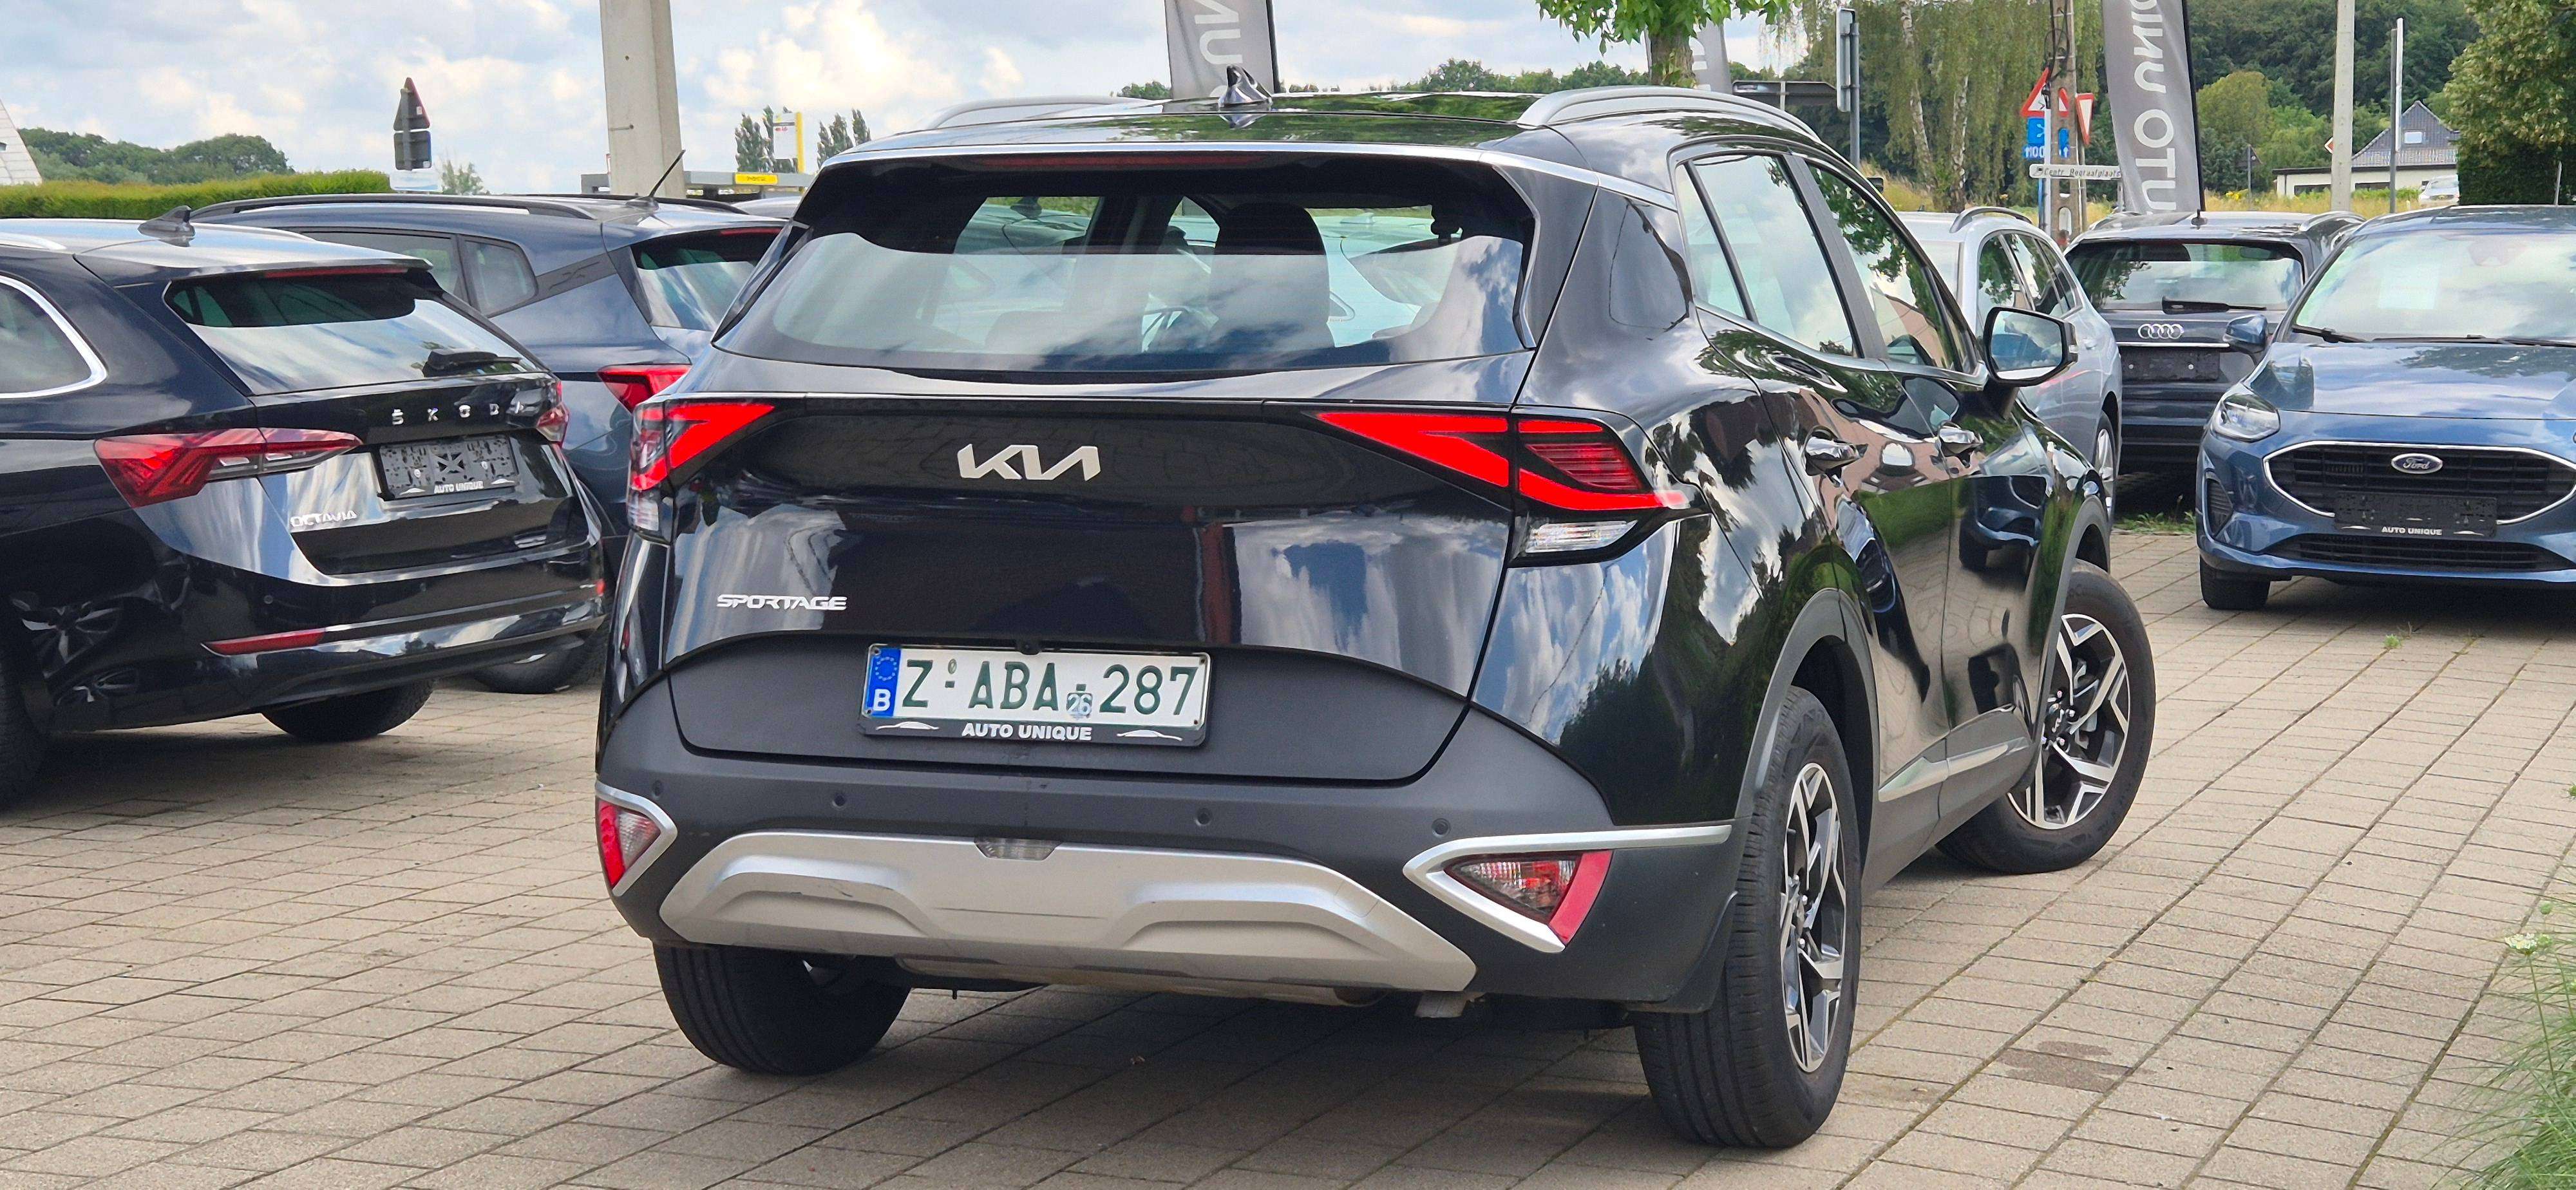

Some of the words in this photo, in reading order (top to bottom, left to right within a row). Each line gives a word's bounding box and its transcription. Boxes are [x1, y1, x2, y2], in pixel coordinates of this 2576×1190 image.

[957, 444, 1101, 481] KIA
[2402, 458, 2430, 470] Ford
[433, 484, 455, 494] AUTO
[290, 510, 357, 527] OCTAVIA
[2382, 526, 2406, 534] AUTO
[2407, 527, 2443, 536] UNIQUE
[717, 594, 848, 610] SPORTAGE
[873, 688, 891, 712] B
[961, 722, 1016, 739] AUTO
[1018, 724, 1092, 741] UNIQUE
